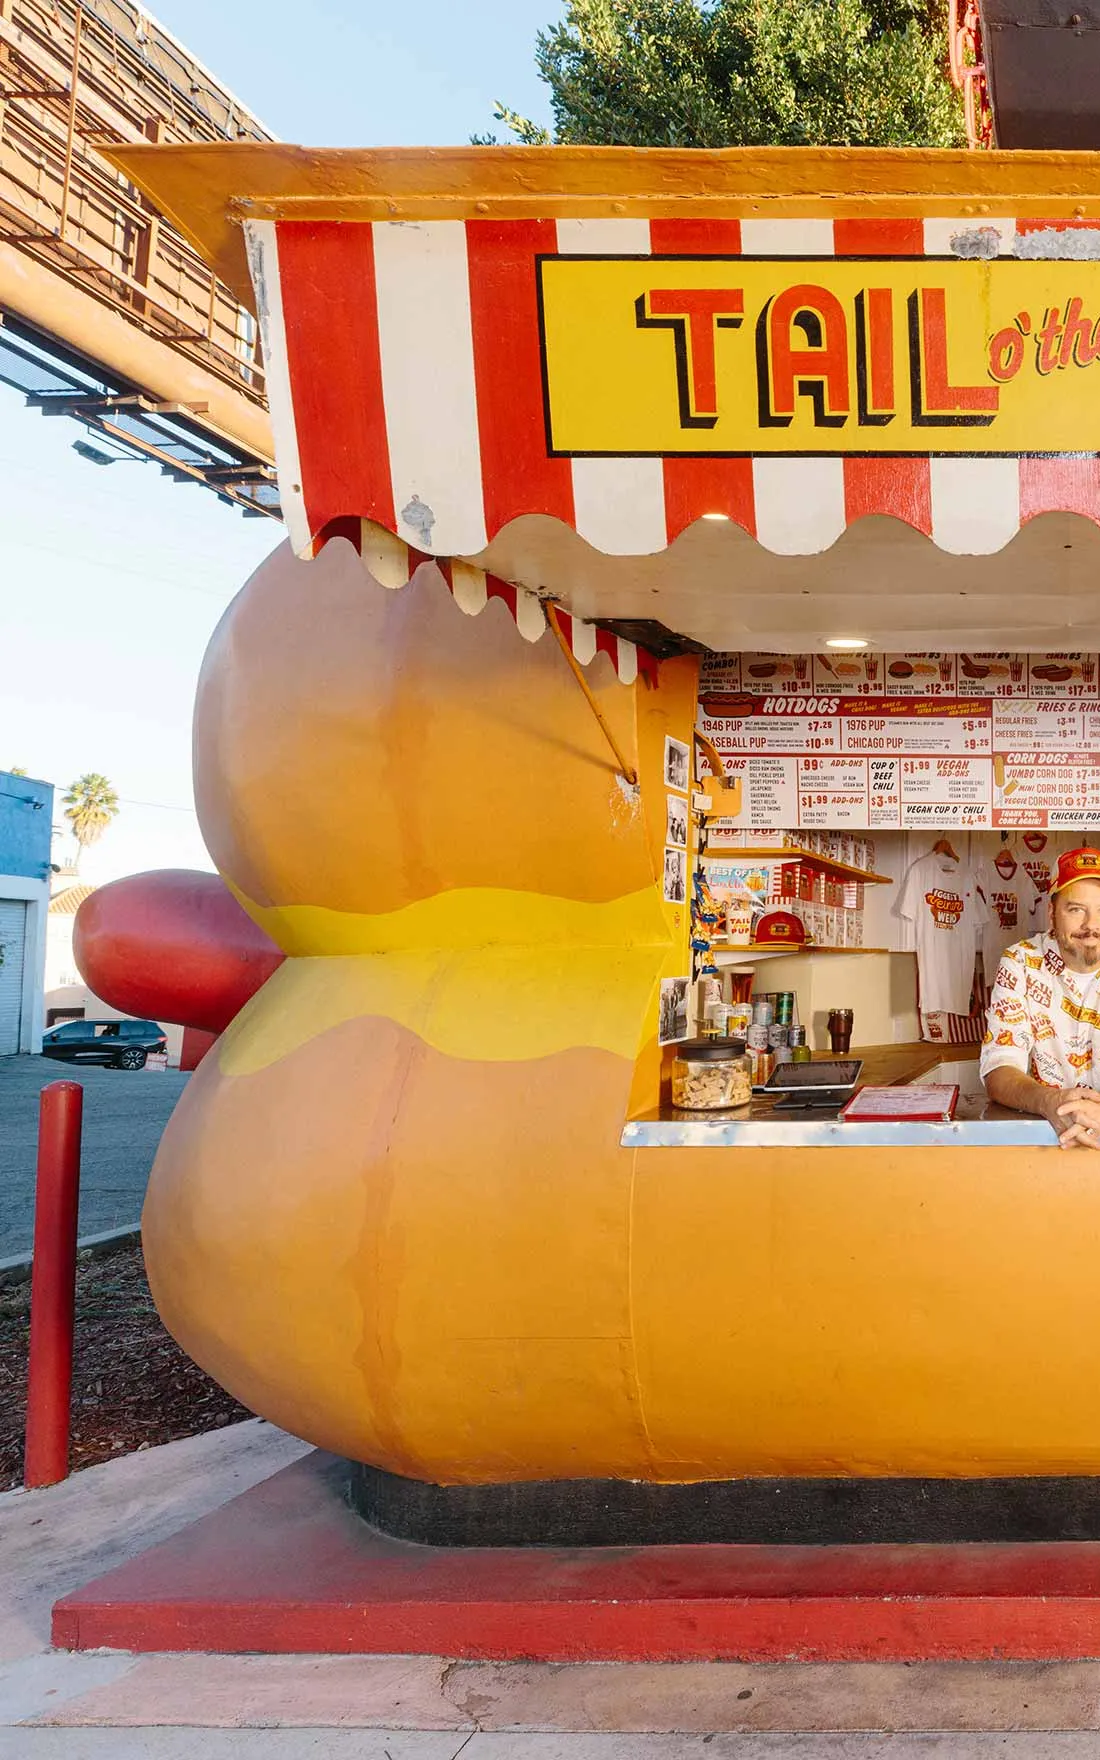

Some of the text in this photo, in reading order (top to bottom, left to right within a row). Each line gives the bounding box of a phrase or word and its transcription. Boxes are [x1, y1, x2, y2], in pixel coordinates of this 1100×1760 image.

[636, 287, 999, 429] TAIL
[703, 657, 738, 671] COMBO!
[762, 697, 840, 714] HOTDOGS
[1036, 702, 1066, 713] FRIES
[1067, 703, 1077, 713] &
[702, 719, 723, 731] 1946
[726, 720, 743, 731] PUP
[846, 719, 866, 731] 1976
[868, 719, 886, 731] PUP
[995, 716, 1038, 725] REGULAR FRIES
[807, 721, 832, 732] $7.25
[995, 730, 1033, 738] CHEESE FRIES
[750, 737, 767, 748] PUP
[847, 737, 884, 749] CHICAGO
[886, 737, 903, 749] PUP
[965, 739, 989, 750] $9.25
[1006, 753, 1036, 764] CORN
[1037, 753, 1068, 765] DOGS
[701, 760, 746, 769] A-ONS
[870, 761, 887, 770] CUP
[903, 760, 970, 773] $1.99 VEGAN
[873, 772, 893, 780] BEEF
[1006, 770, 1073, 779] JUMBO CORN DOG
[872, 782, 894, 791] CHILI
[1036, 784, 1057, 793] CORN
[1058, 784, 1073, 793] DOG
[801, 795, 828, 808] $1.99
[871, 795, 898, 808] $3.95
[1004, 796, 1063, 806] VEGGIE CORNDOG
[1076, 797, 1100, 808] $7.75
[906, 805, 933, 814] VEGAN
[934, 805, 951, 814] CUP
[963, 805, 985, 814] CHILI
[1001, 810, 1023, 818] THANK
[998, 817, 1016, 825] COME
[1016, 817, 1042, 825] AGAIN!
[1050, 812, 1084, 821] CHICKEN
[710, 866, 733, 876] BEST
[1003, 1003, 1022, 1013] PUP
